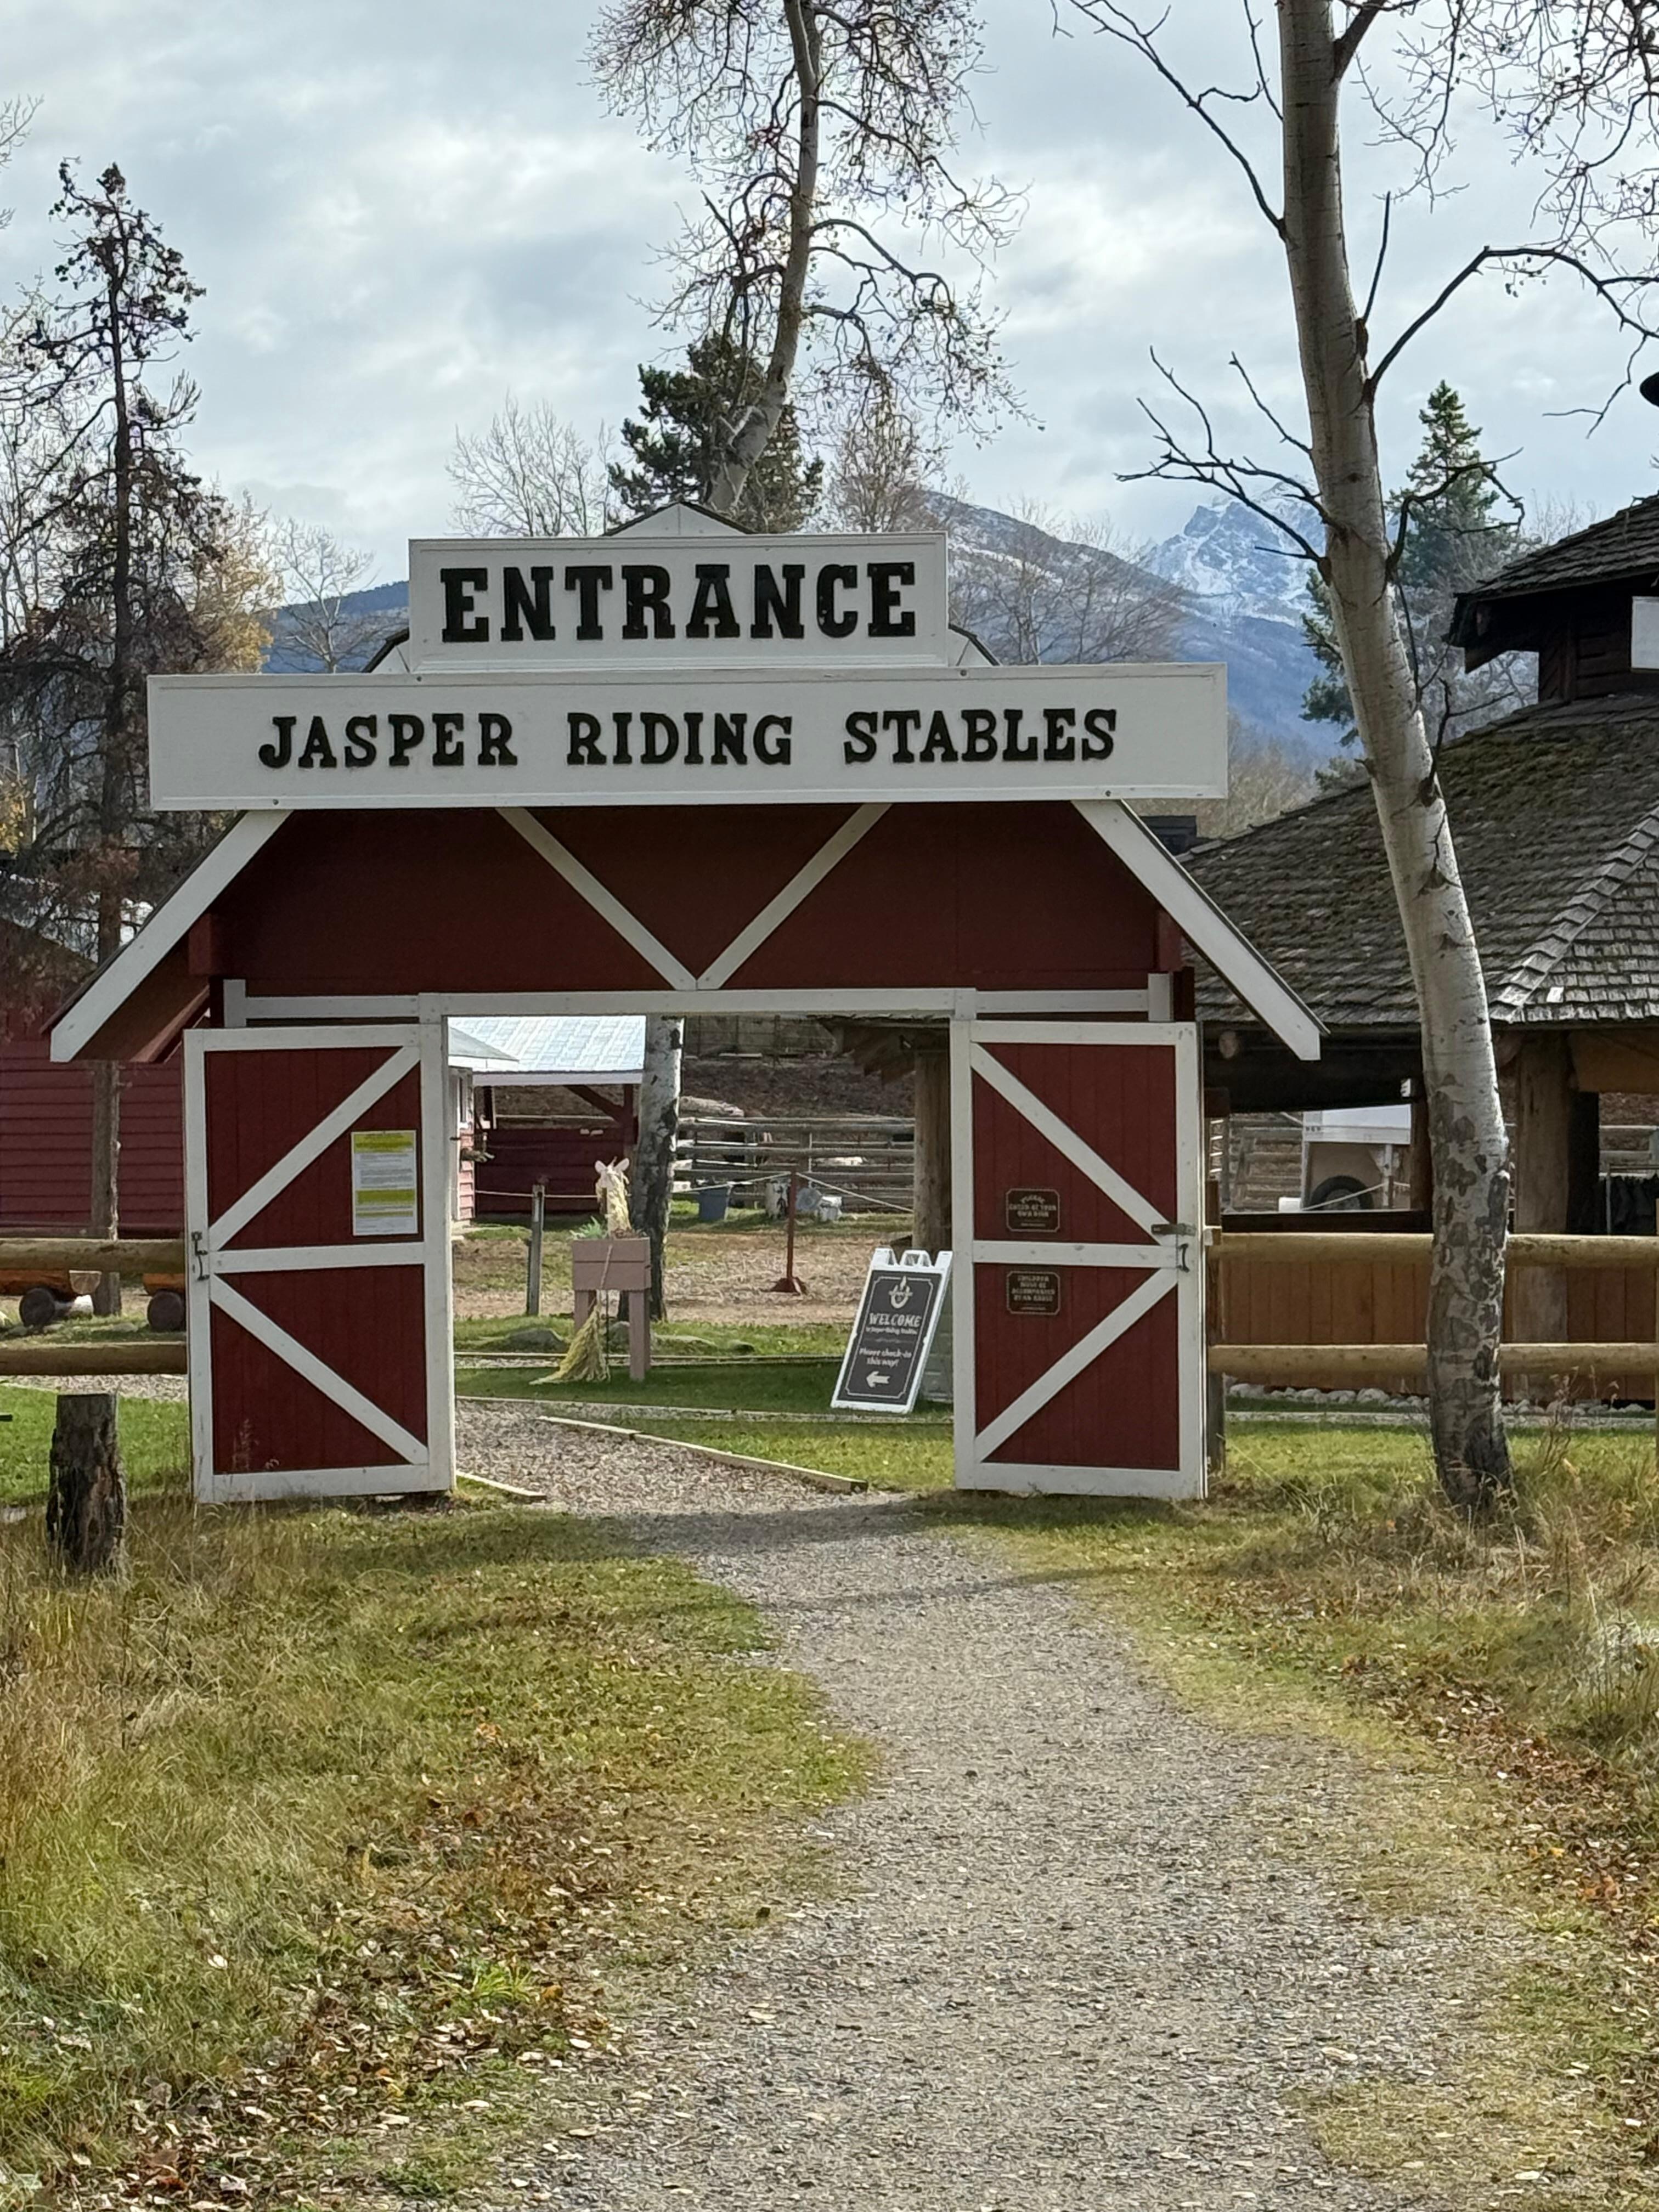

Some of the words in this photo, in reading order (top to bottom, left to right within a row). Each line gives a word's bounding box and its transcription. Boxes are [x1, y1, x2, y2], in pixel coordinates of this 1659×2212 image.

[440, 562, 916, 644] ENTRANCE
[258, 713, 518, 769] JASPER
[567, 712, 792, 766] RIDING
[843, 708, 1117, 765] STABLES
[869, 1312, 922, 1327] WELCOME
